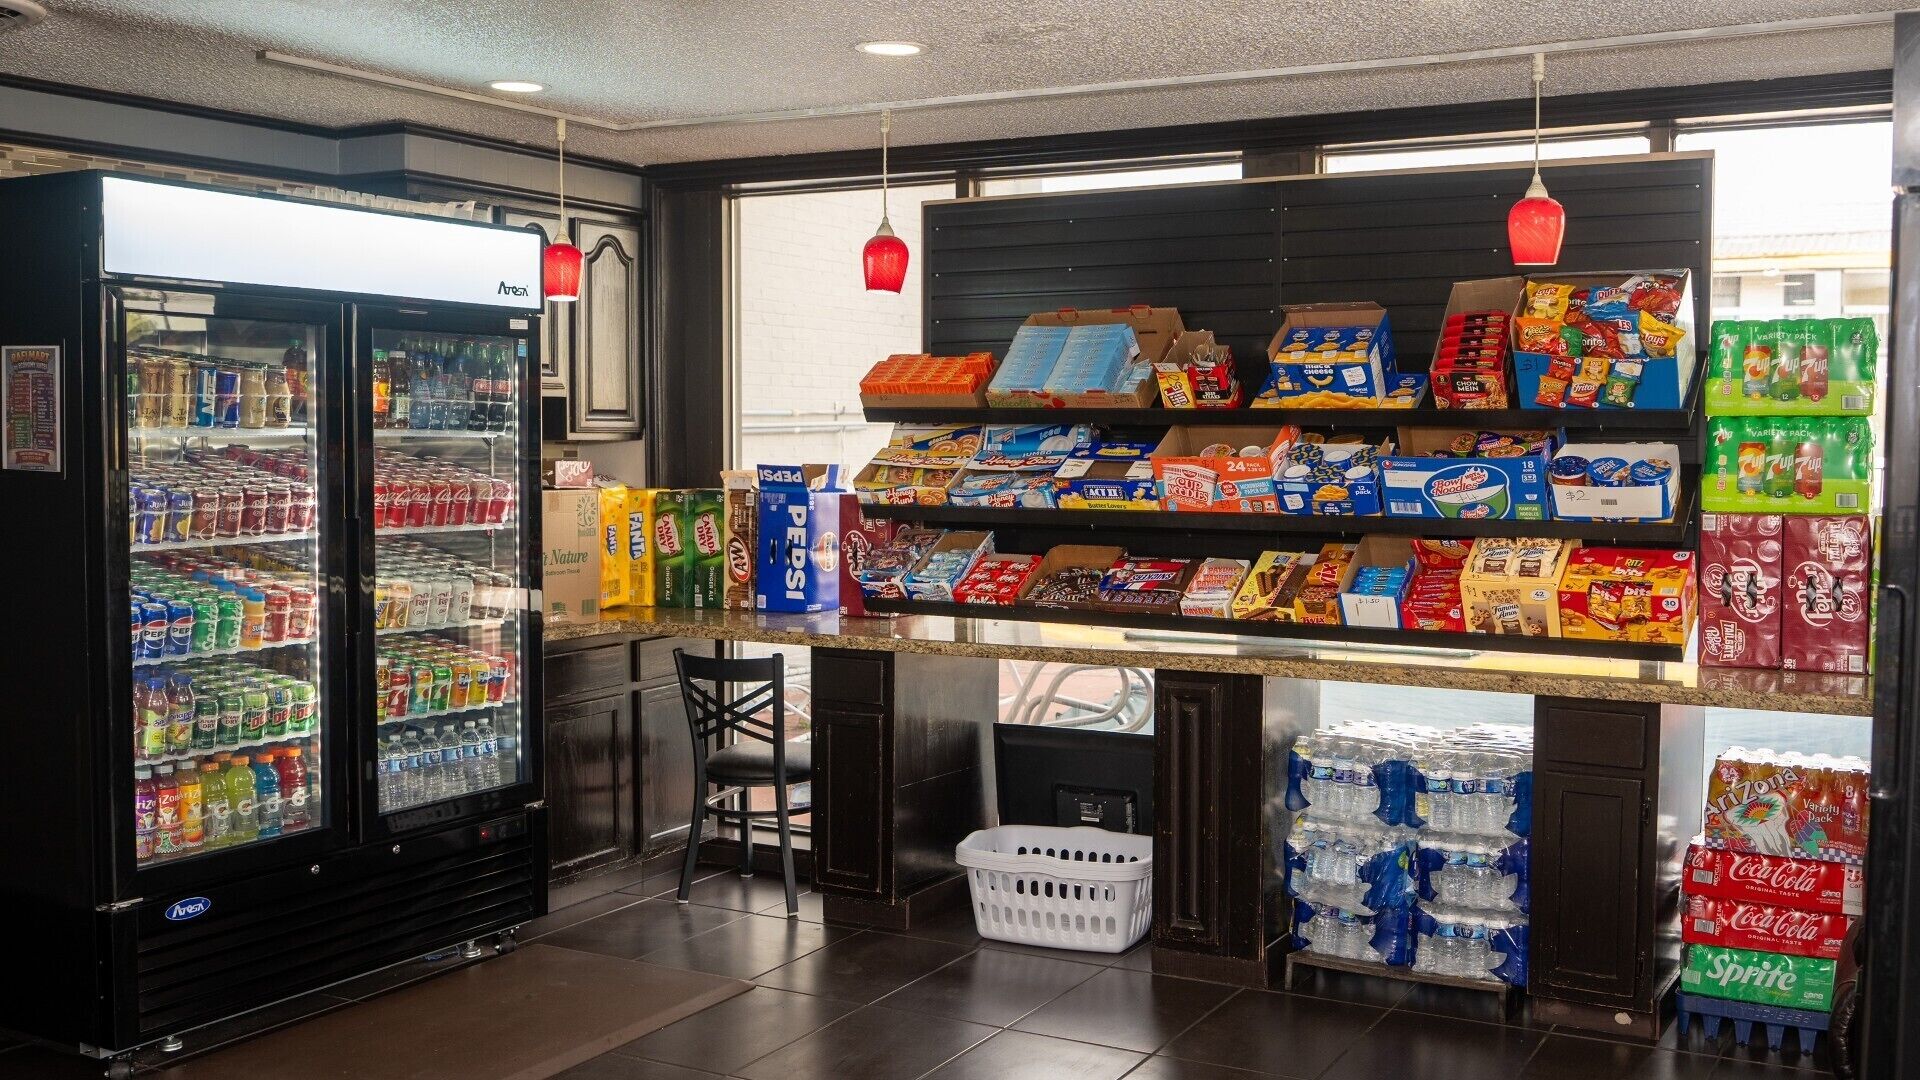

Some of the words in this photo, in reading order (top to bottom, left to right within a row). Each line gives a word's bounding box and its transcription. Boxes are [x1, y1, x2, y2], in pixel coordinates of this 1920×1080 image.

[1644, 332, 1666, 345] Lay's
[1756, 332, 1791, 341] VARIETY
[1794, 333, 1817, 341] PACK
[1743, 357, 1770, 383] 7up
[1800, 357, 1828, 382] 7up
[1574, 383, 1597, 393] Fritos
[1751, 429, 1786, 438] VARIETY
[885, 453, 924, 469] Honey
[982, 455, 1021, 468] Honey
[1022, 450, 1053, 458] JUMBO
[1226, 461, 1247, 472] 24
[1738, 453, 1765, 478] 7up
[1765, 453, 1794, 480] 7up
[1795, 454, 1822, 480] 7up
[760, 469, 804, 484] PEPSI
[1175, 477, 1203, 490] CUP
[1432, 476, 1464, 488] Bowl
[886, 487, 917, 498] Honey
[1088, 488, 1107, 497] ACT
[1167, 484, 1209, 502] NOODLES
[1432, 482, 1479, 497] Noodles
[1566, 490, 1591, 502] $2
[988, 493, 1016, 502] Honey
[607, 524, 618, 556] FANTA
[629, 512, 647, 561] FANTA
[656, 526, 667, 548] DRY
[661, 513, 677, 556] CANADA
[696, 526, 707, 548] DRY
[701, 513, 716, 556] CANADA
[1829, 523, 1842, 562] TAILGATE
[550, 548, 589, 567] Nature
[728, 543, 748, 573] A&W
[785, 505, 808, 600] PEPSI
[1625, 558, 1645, 568] RITZ
[1710, 573, 1722, 588] 23
[1592, 585, 1618, 602] bits
[1623, 585, 1651, 596] bits
[1183, 607, 1213, 616] PAYDAY
[1492, 603, 1519, 616] Famous
[1842, 598, 1854, 613] 23
[1496, 610, 1518, 620] Amos
[1724, 623, 1734, 660] TAILGATE
[1784, 658, 1792, 669] 36
[1704, 767, 1799, 825] AriZona
[1845, 786, 1854, 799] 8
[1803, 799, 1840, 816] Variety
[1808, 812, 1834, 824] Pack
[1729, 855, 1818, 892] Coca-Cola
[1745, 885, 1777, 894] ORIGINAL
[1779, 889, 1801, 898] TASTE
[1730, 905, 1819, 941] Coca-Cola
[1747, 934, 1779, 943] ORIGINAL
[1781, 938, 1803, 947] TASTE
[1705, 954, 1798, 991] Sprite
